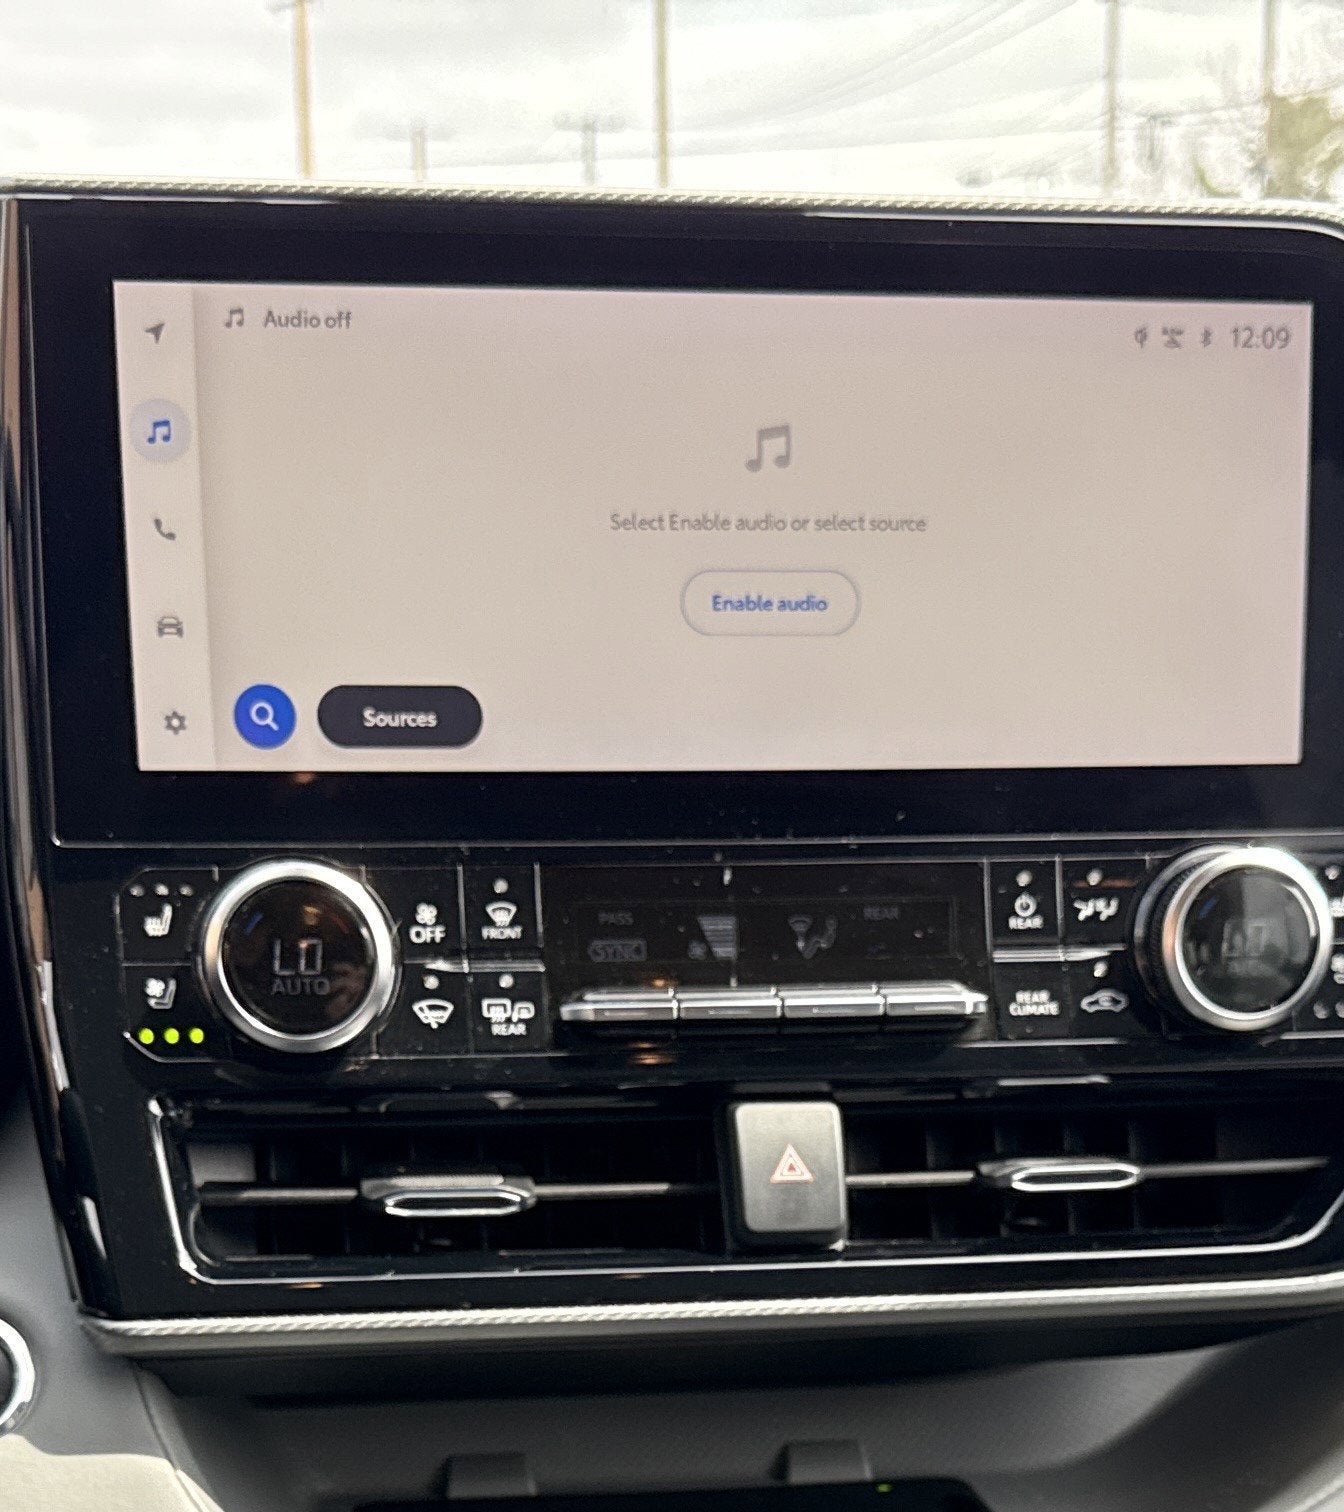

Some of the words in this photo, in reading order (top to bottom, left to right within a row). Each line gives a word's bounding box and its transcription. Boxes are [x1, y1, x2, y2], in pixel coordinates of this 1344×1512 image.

[263, 308, 321, 330] Audio
[324, 309, 352, 331] off
[1230, 325, 1291, 350] 12:09
[609, 511, 665, 532] Select
[668, 513, 731, 532] Enable
[735, 514, 787, 532] audio
[791, 519, 810, 532] or
[814, 515, 866, 533] select
[869, 518, 928, 533] source
[711, 594, 774, 613] Enable
[777, 595, 829, 613] audio
[362, 706, 438, 729] Sources
[1008, 914, 1044, 930] REAR
[409, 926, 446, 944] OFF
[481, 927, 523, 940] FRONT
[270, 978, 330, 996] AUTO
[1015, 990, 1051, 1004] REAR
[1009, 1001, 1060, 1016] CLIMATE
[491, 1023, 527, 1037] REAR
